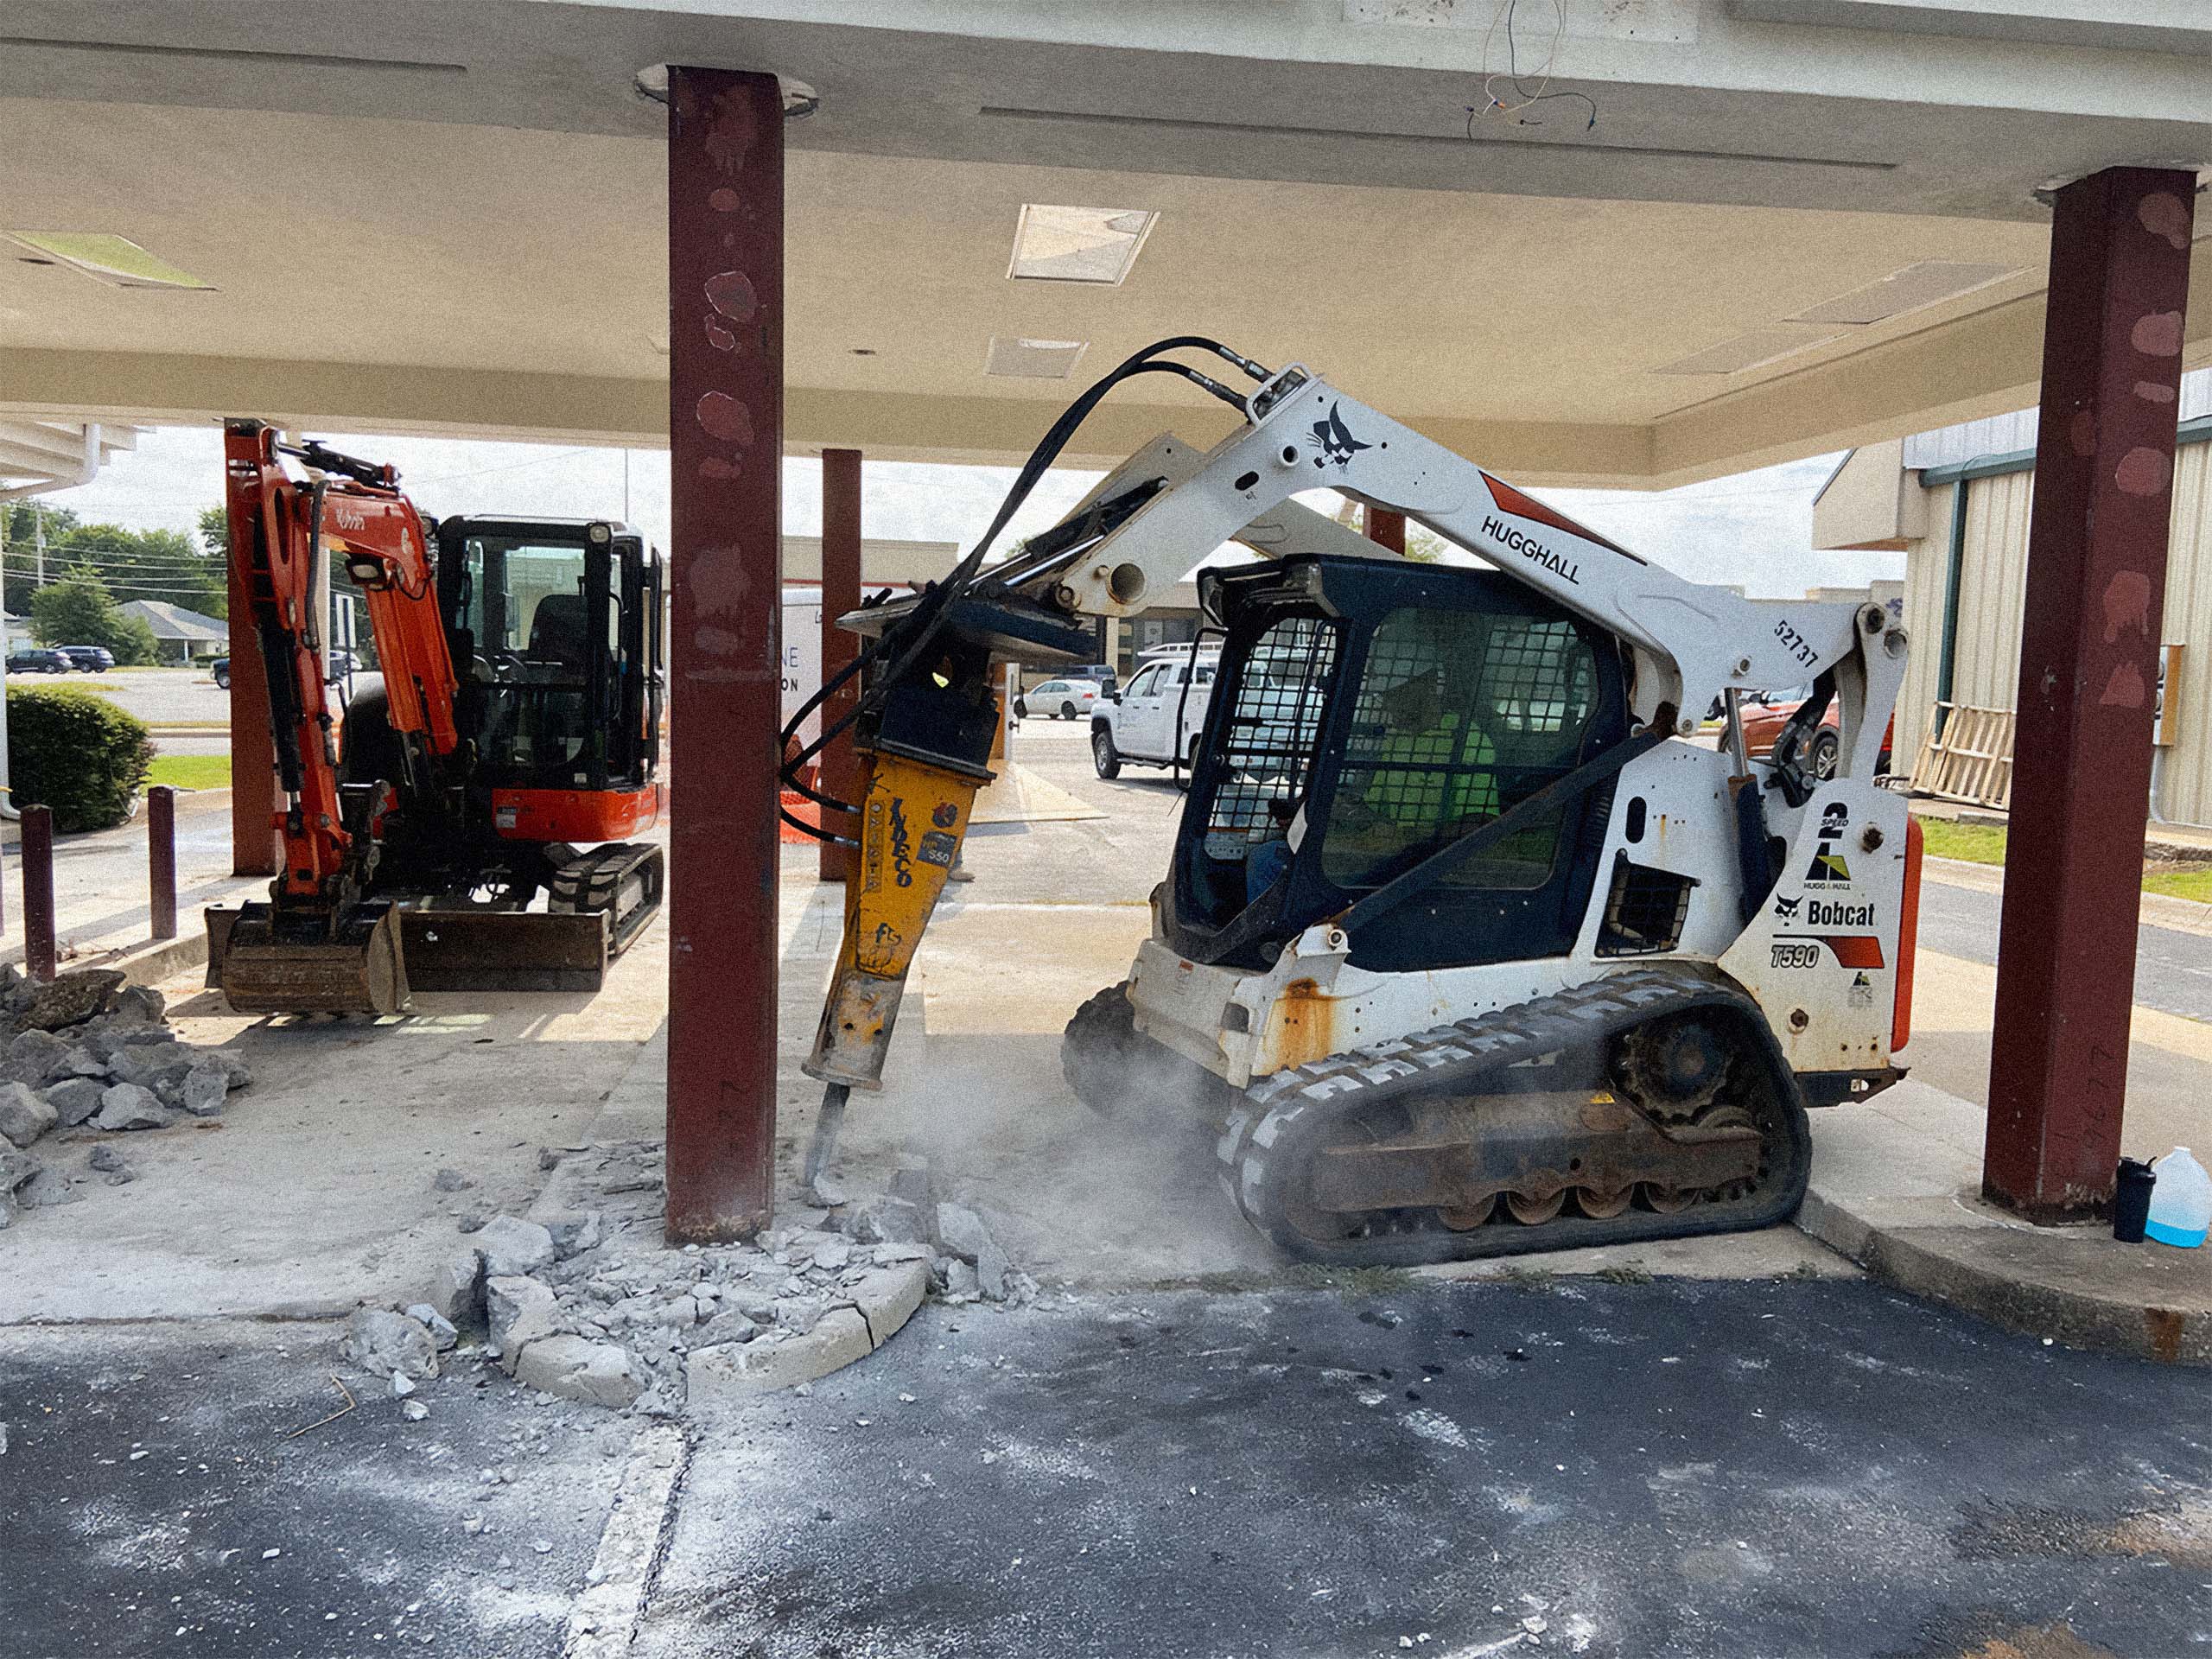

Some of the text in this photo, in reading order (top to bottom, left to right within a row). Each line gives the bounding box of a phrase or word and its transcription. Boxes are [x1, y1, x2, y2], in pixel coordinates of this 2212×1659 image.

[1481, 515, 1580, 585] HUGGHALL
[1774, 620, 1819, 668] 52737
[1818, 802, 1848, 839] 2
[1821, 818, 1849, 827] SPEED
[1808, 900, 1875, 926] Bobcat
[1771, 944, 1820, 969] T590
